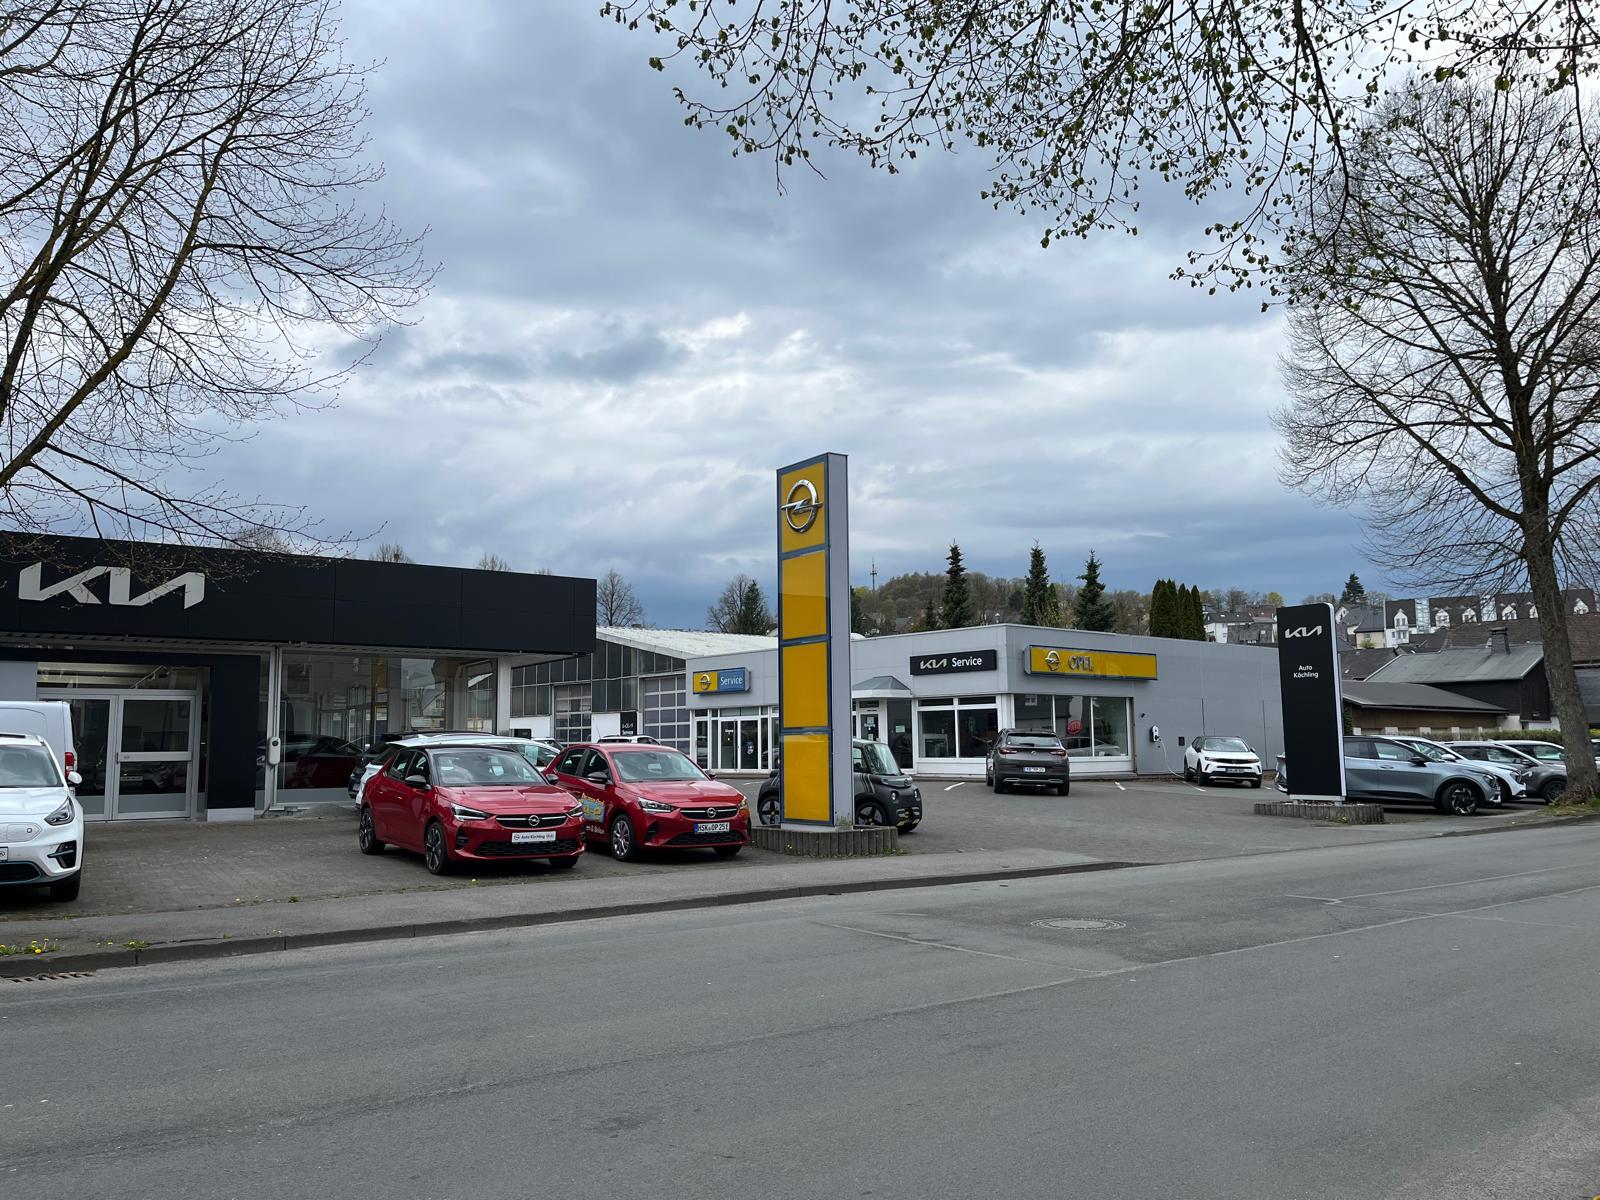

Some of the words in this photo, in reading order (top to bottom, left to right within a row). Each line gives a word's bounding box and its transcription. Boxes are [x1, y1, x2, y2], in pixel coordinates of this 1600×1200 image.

[18, 561, 205, 610] KIA
[1284, 625, 1322, 638] KIA
[920, 658, 947, 669] KIA
[951, 656, 982, 667] Service
[720, 676, 743, 685] Service
